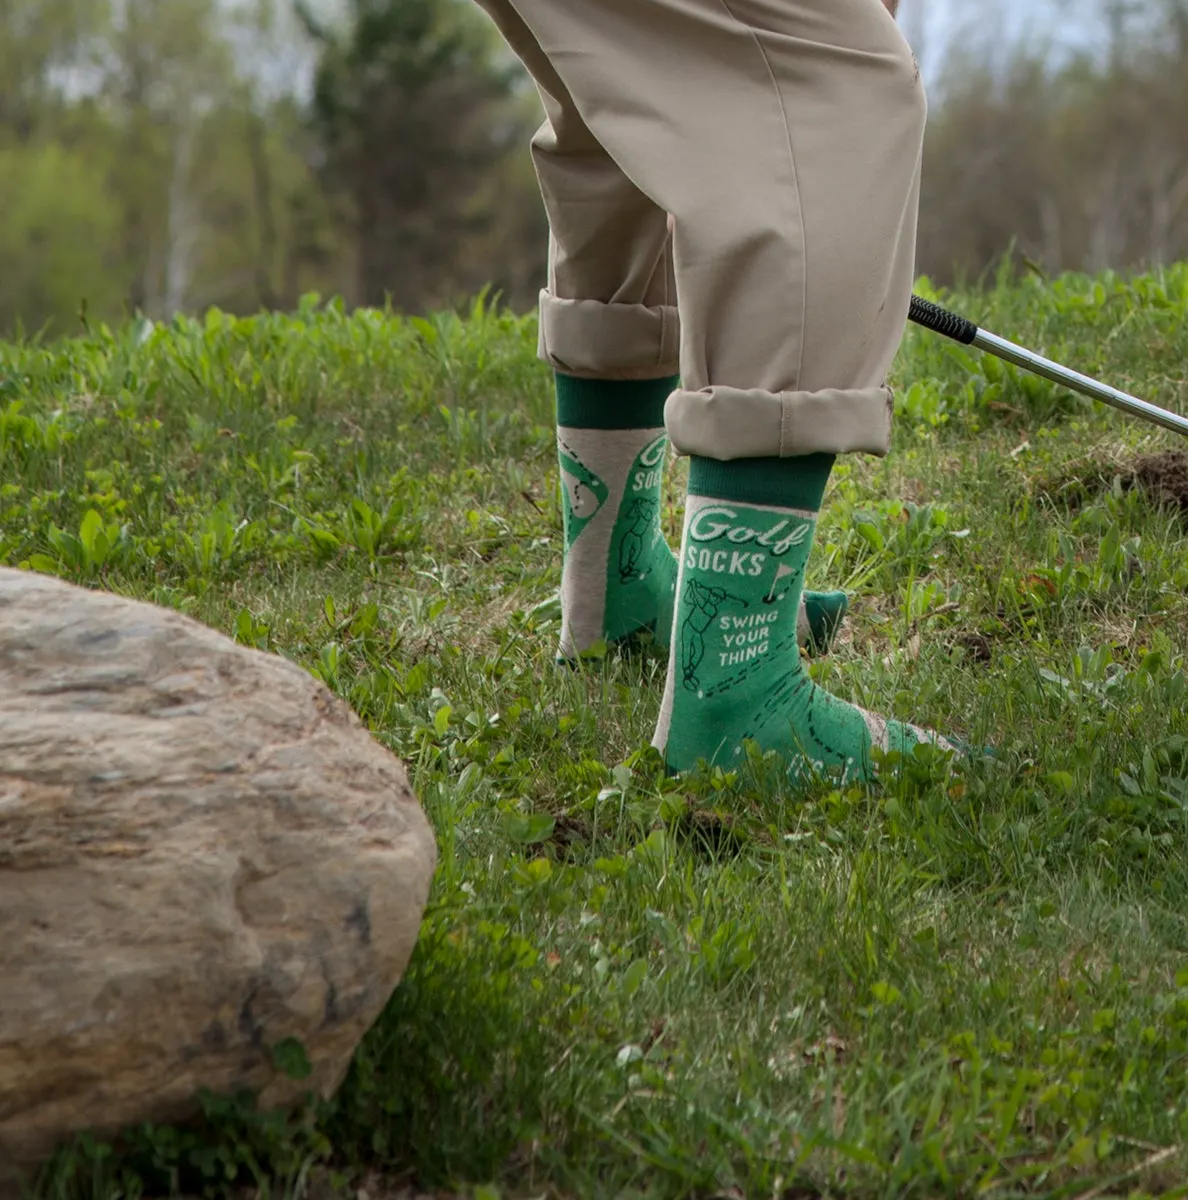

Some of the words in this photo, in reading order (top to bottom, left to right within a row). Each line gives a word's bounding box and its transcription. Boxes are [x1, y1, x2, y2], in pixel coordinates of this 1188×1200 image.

[689, 507, 810, 555] Golf
[687, 546, 765, 577] SOCKS
[719, 611, 778, 630] SWING
[723, 627, 770, 648] YOUR
[719, 641, 769, 666] THING
